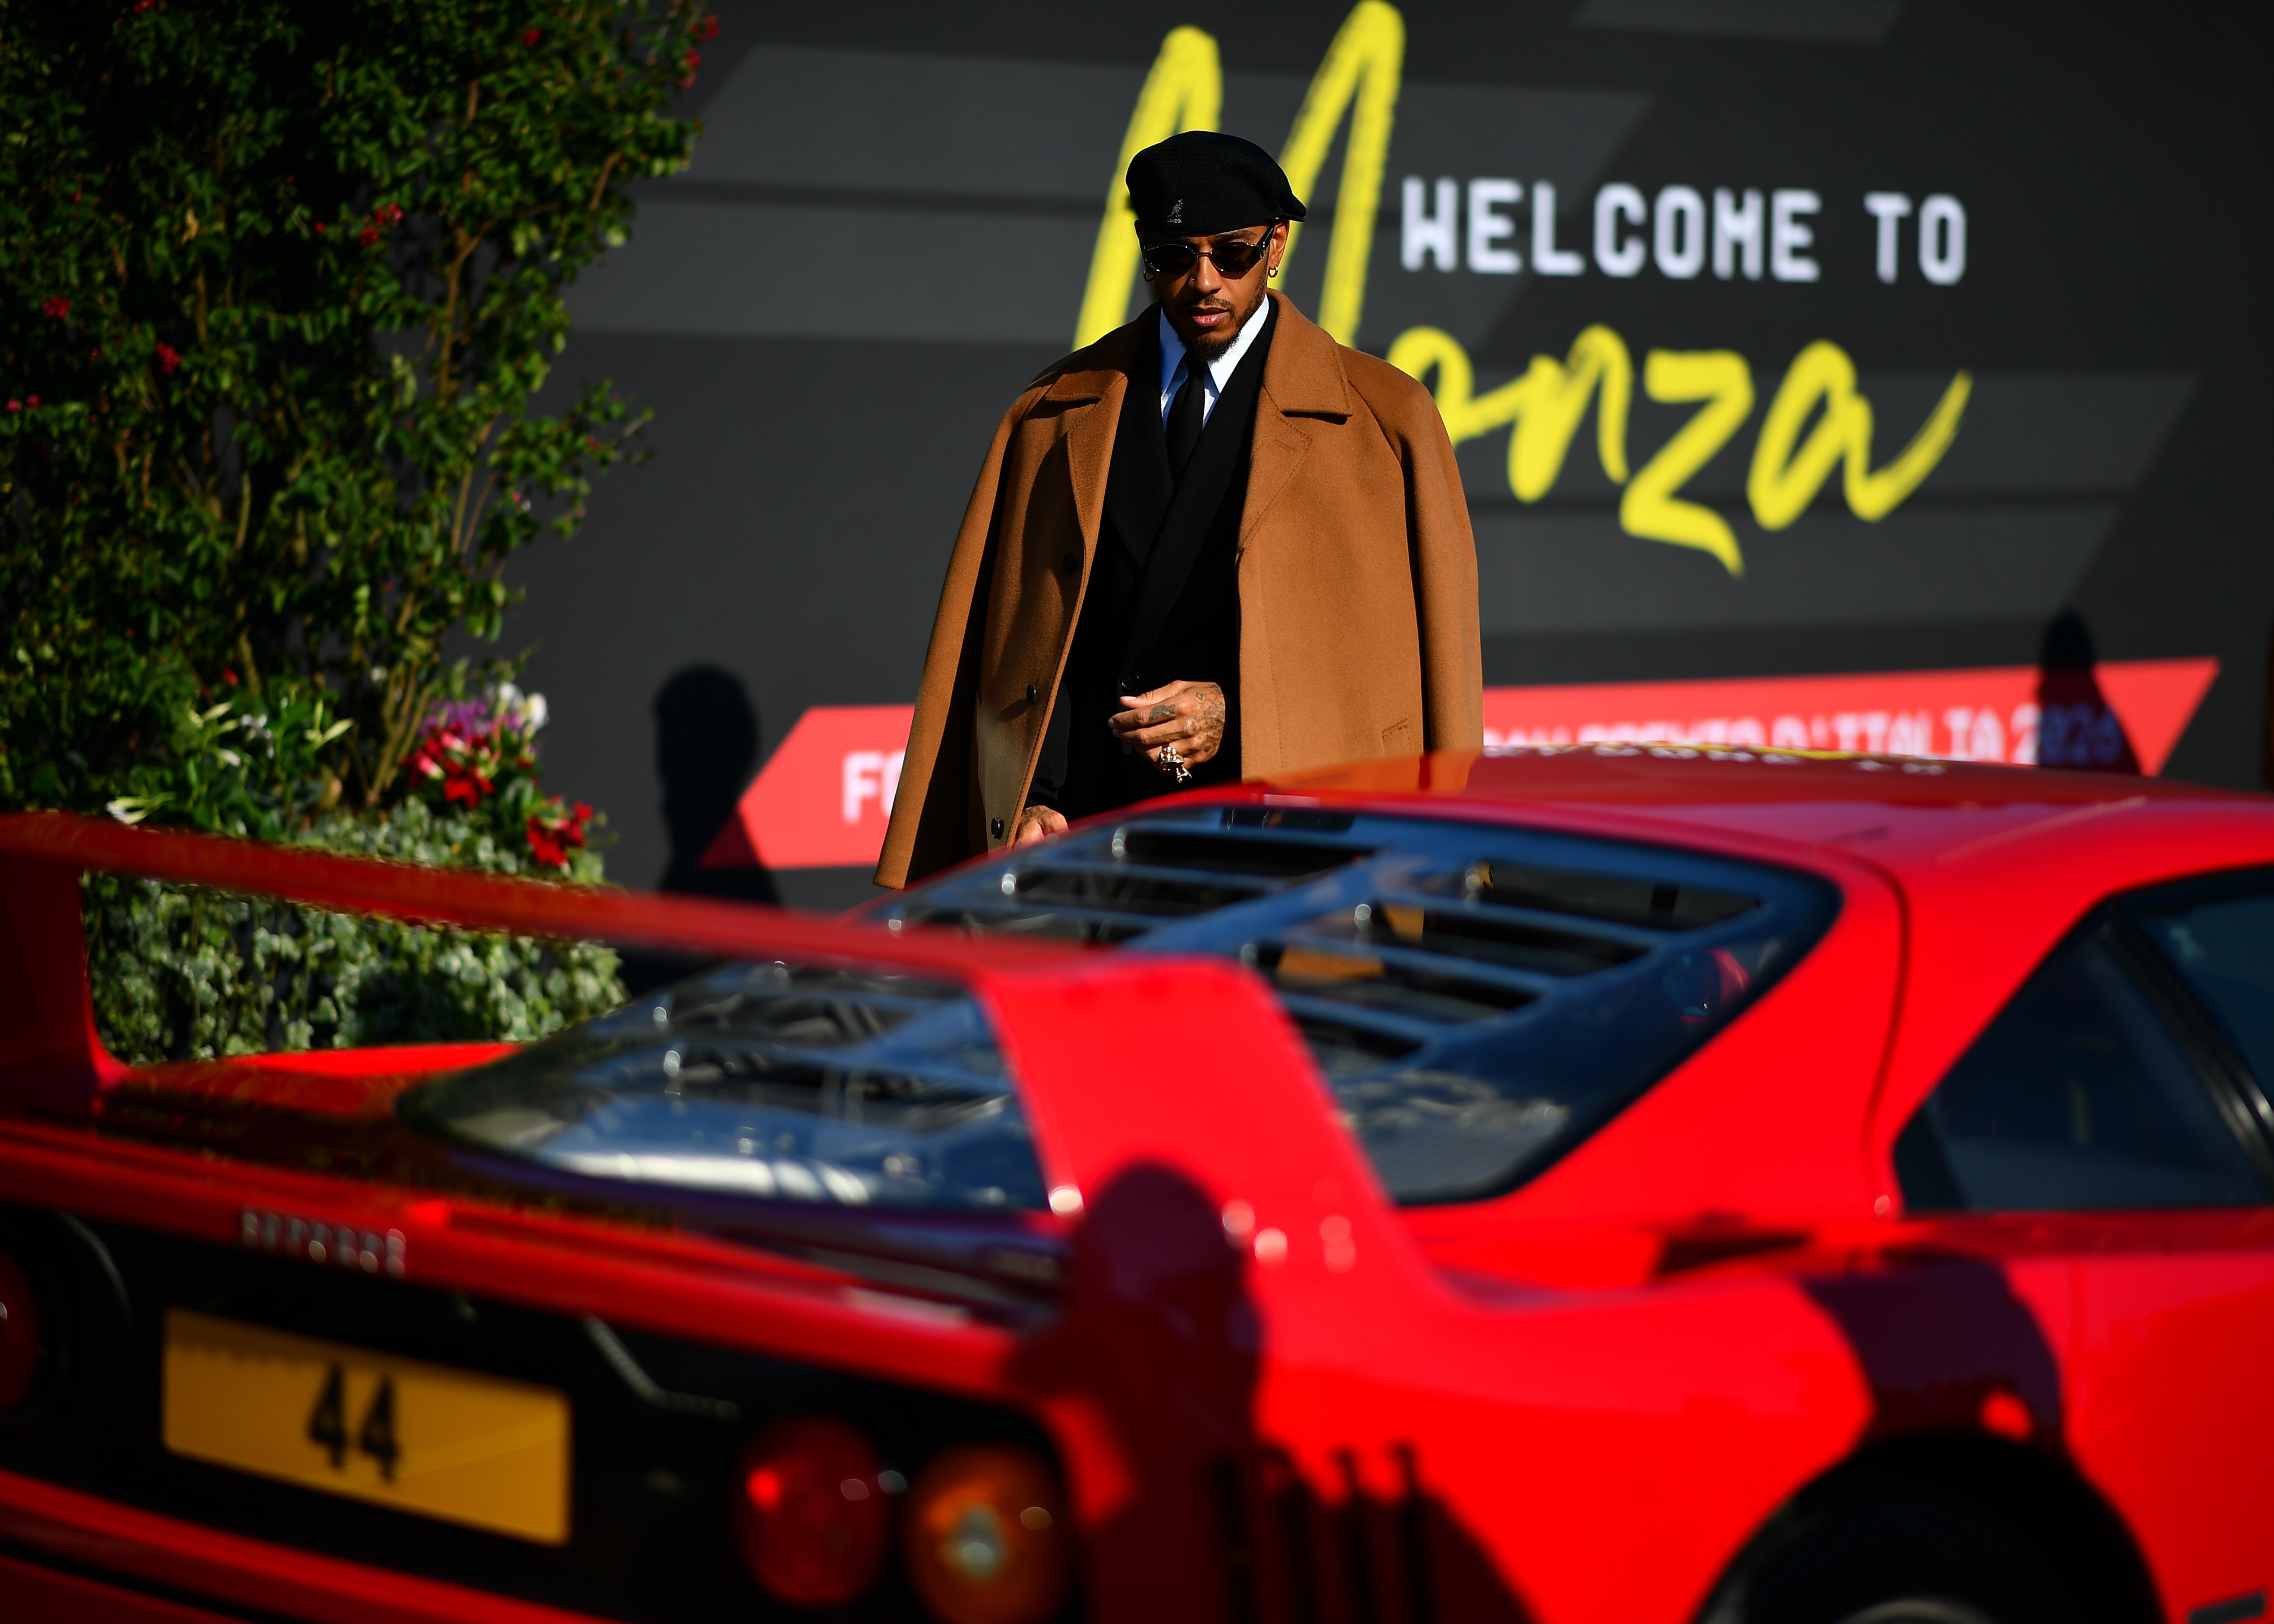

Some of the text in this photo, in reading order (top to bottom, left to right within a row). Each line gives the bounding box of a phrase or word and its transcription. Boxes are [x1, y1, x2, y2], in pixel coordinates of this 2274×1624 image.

[1072, 0, 1970, 575] Monza
[1401, 175, 1966, 286] WELCOME TO
[306, 1361, 400, 1484] 44
